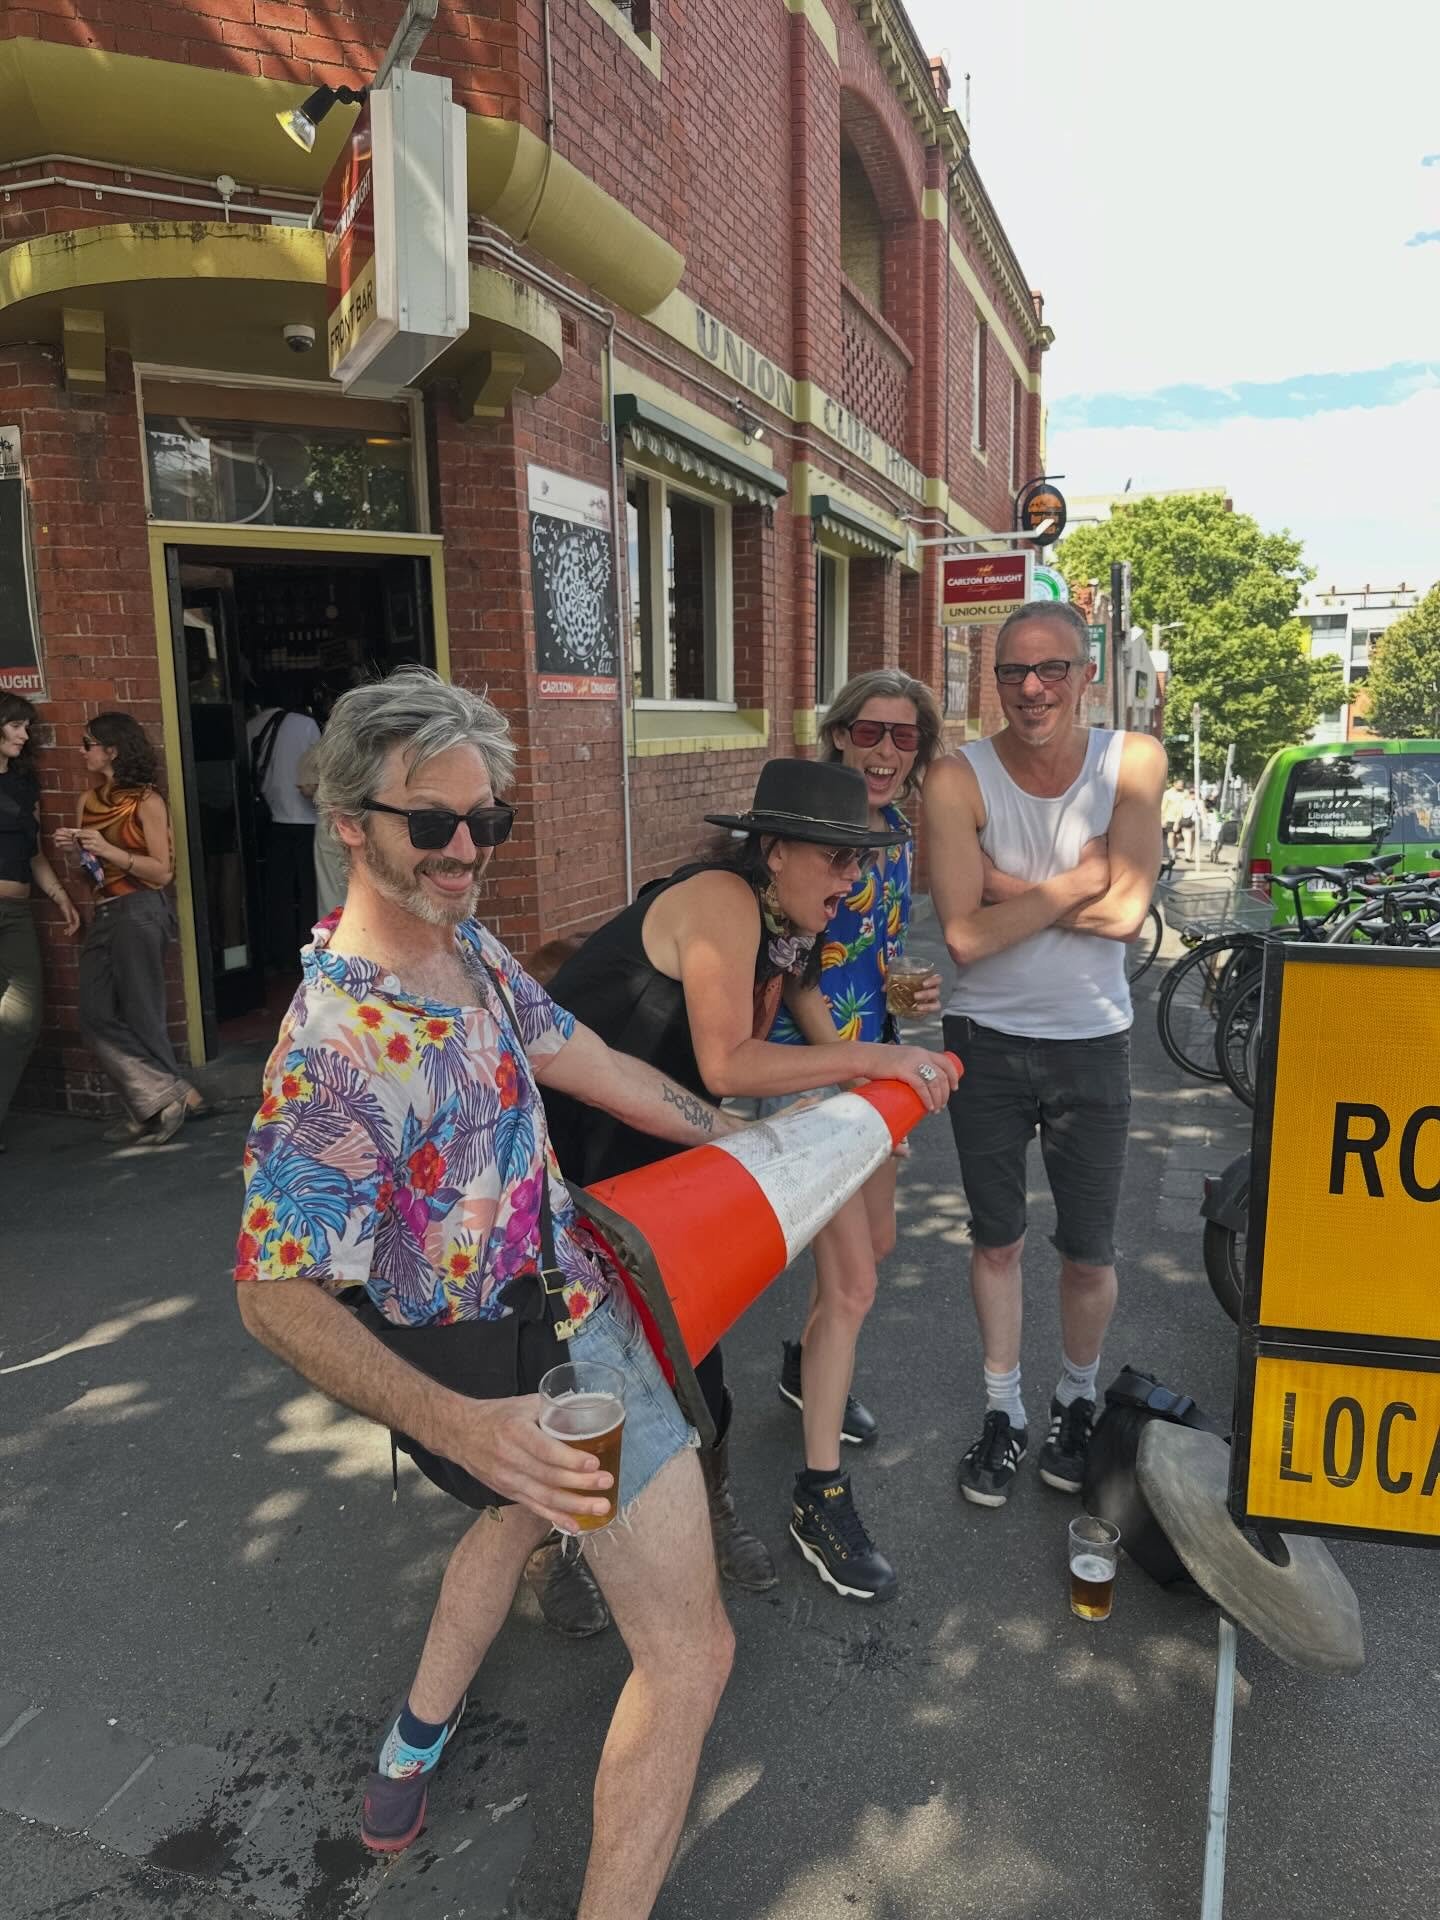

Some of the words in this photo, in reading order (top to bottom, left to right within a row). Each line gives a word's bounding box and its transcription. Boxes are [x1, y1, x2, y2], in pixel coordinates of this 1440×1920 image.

[330, 310, 354, 349] FRONT
[354, 279, 374, 324] BAR
[696, 308, 794, 416] UNION
[823, 398, 873, 463] CLUB
[946, 577, 983, 587] CARLTON
[984, 574, 1023, 585] DRAUGHT
[949, 606, 986, 618] UNION
[540, 680, 574, 694] CARLTON
[1308, 812, 1346, 820] Libraries
[824, 1486, 845, 1498] FILA
